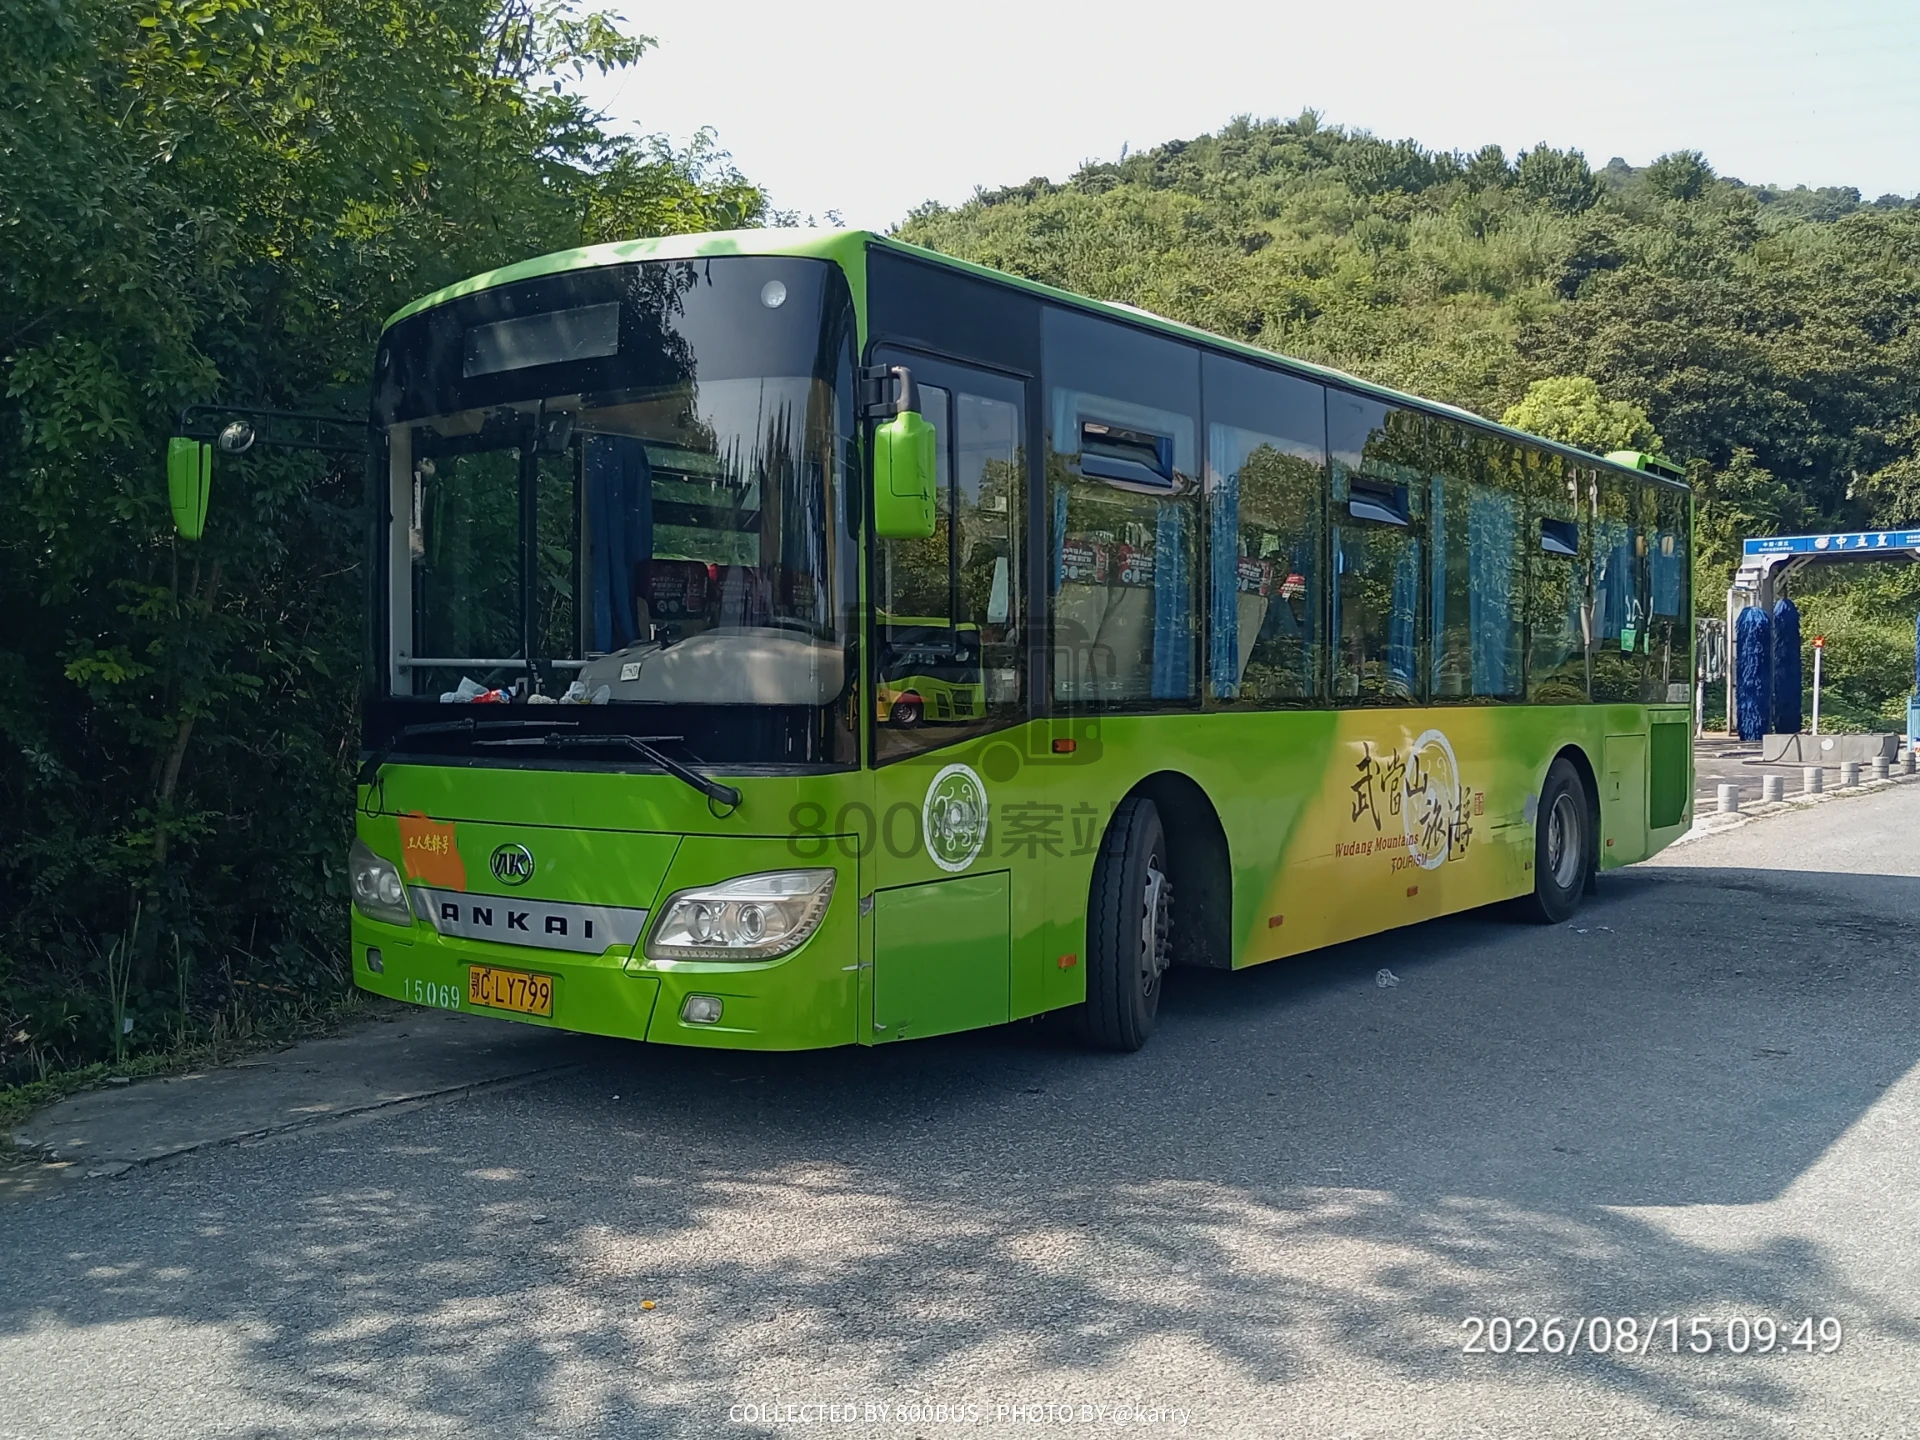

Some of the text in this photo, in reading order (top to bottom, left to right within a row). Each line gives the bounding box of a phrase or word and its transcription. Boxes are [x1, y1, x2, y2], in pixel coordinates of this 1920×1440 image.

[1335, 832, 1419, 858] Wudang Mountains
[1391, 852, 1428, 873] TOURISM
[441, 902, 594, 939] ANKAI
[404, 977, 461, 1009] 15069
